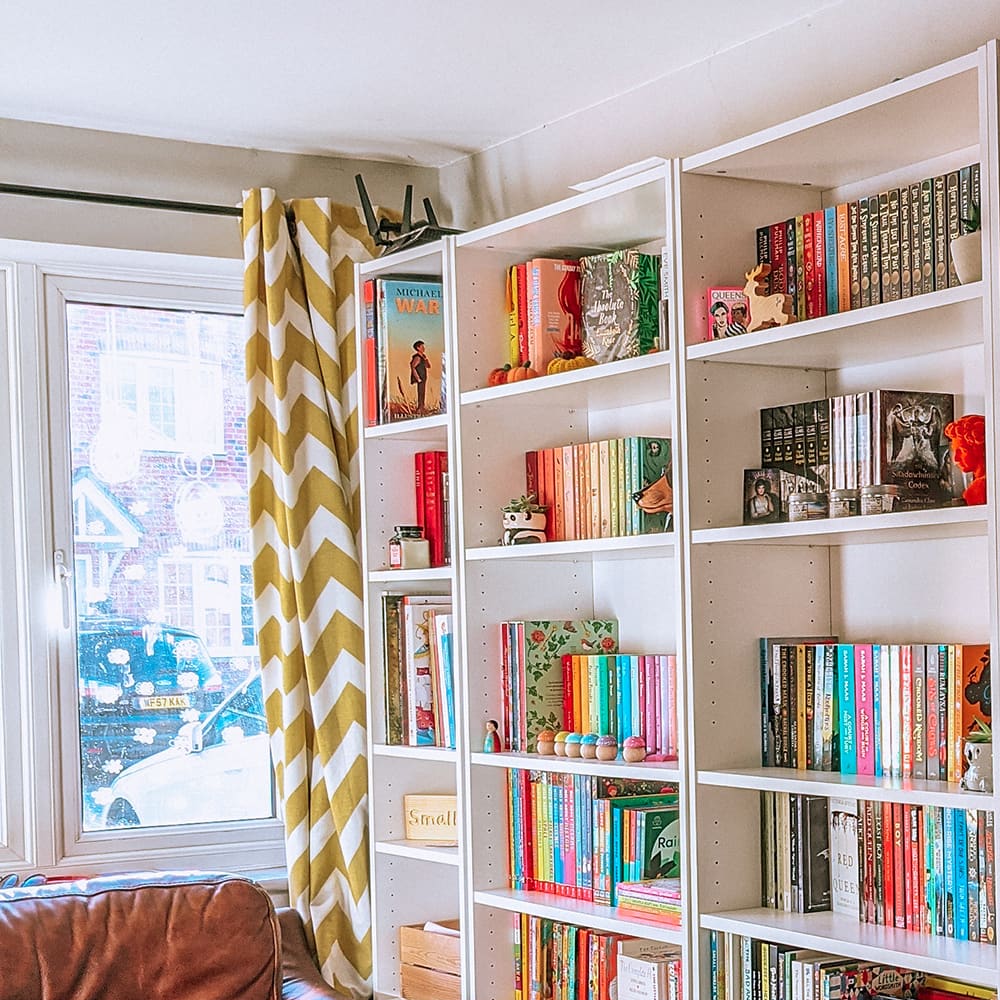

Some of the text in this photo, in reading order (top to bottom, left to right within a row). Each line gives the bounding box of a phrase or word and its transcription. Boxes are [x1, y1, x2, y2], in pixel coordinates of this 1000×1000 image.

[396, 287, 443, 298] MICHAEL
[602, 289, 613, 299] The
[395, 297, 440, 315] WAR
[591, 299, 625, 313] Absolute
[599, 312, 618, 326] Book
[928, 677, 938, 758] SIX CROWS
[913, 724, 922, 763] KINGDOM
[408, 809, 457, 827] Small
[657, 836, 678, 849] Rai
[837, 852, 854, 868] RED
[878, 971, 900, 984] Little
